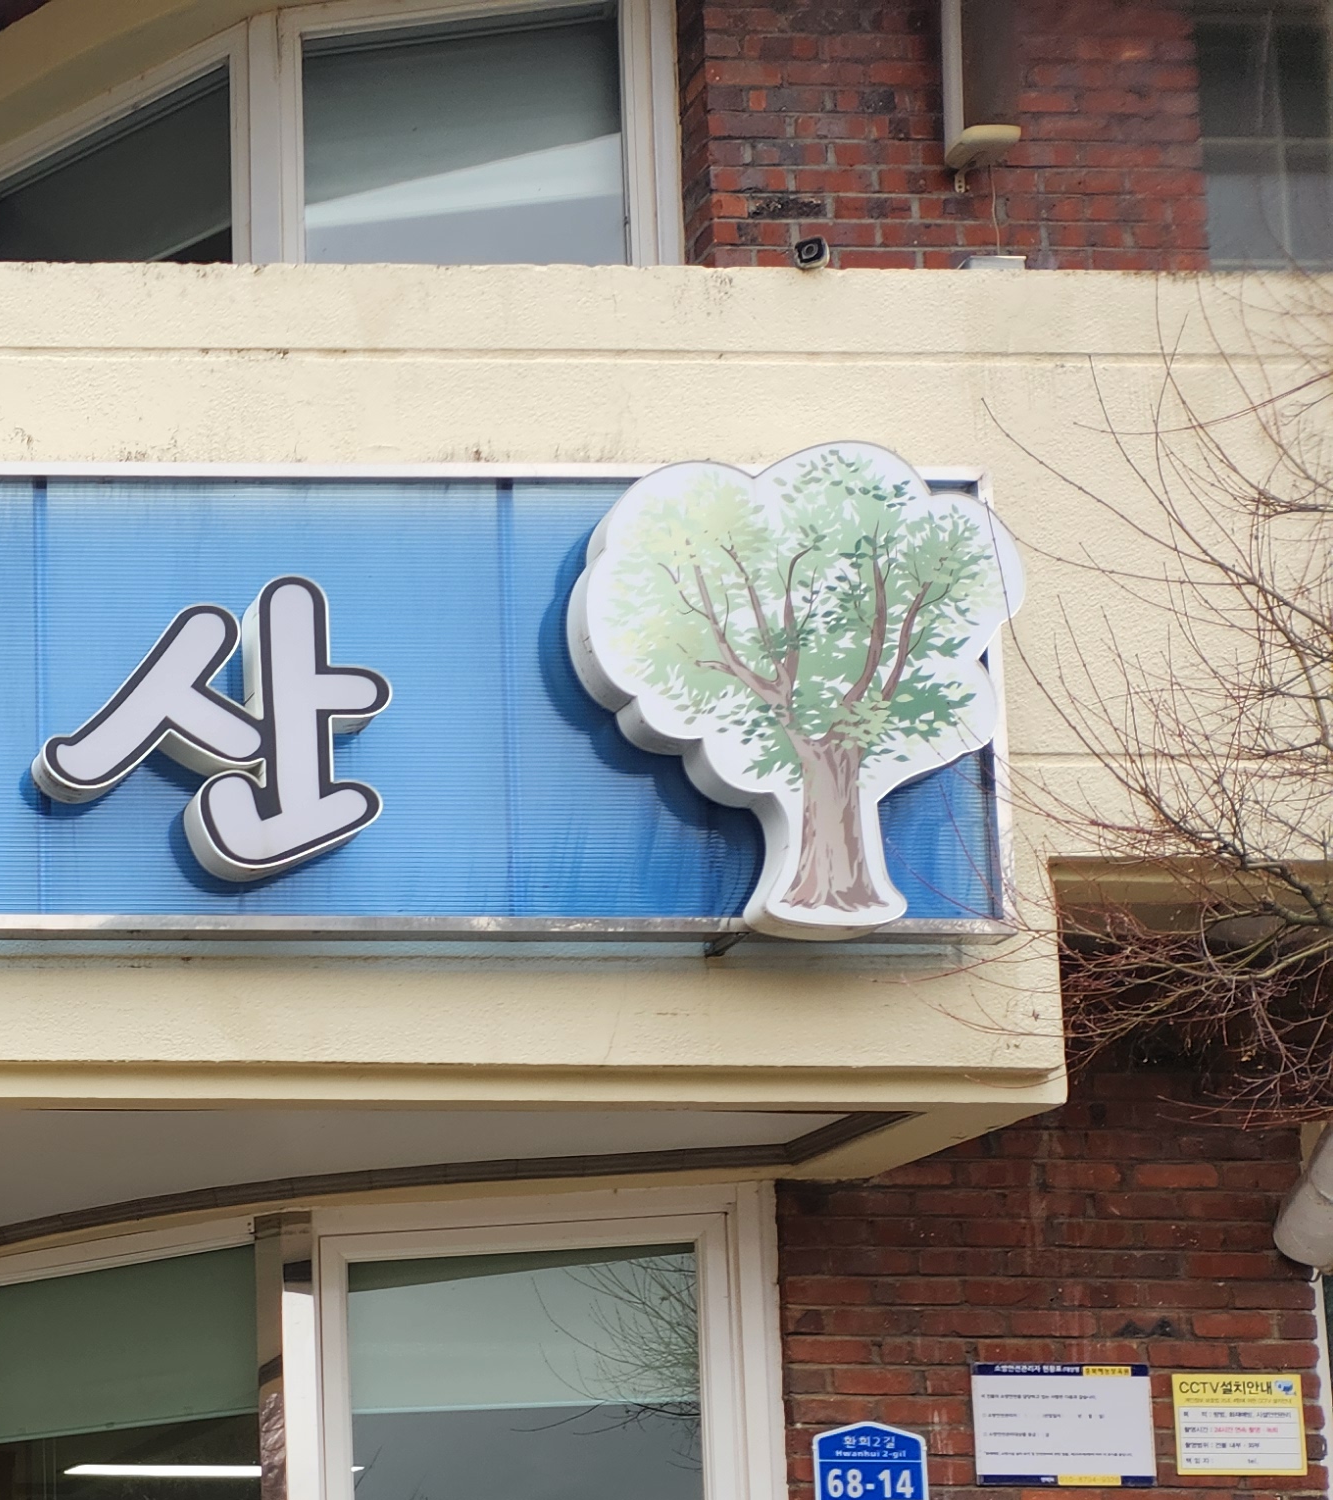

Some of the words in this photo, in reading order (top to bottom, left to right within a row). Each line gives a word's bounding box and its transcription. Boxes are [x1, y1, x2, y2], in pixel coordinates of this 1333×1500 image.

[1179, 1381, 1272, 1395] CCTV설치안내
[882, 1450, 906, 1459] 2-gil
[827, 1468, 914, 1498] 68-14
